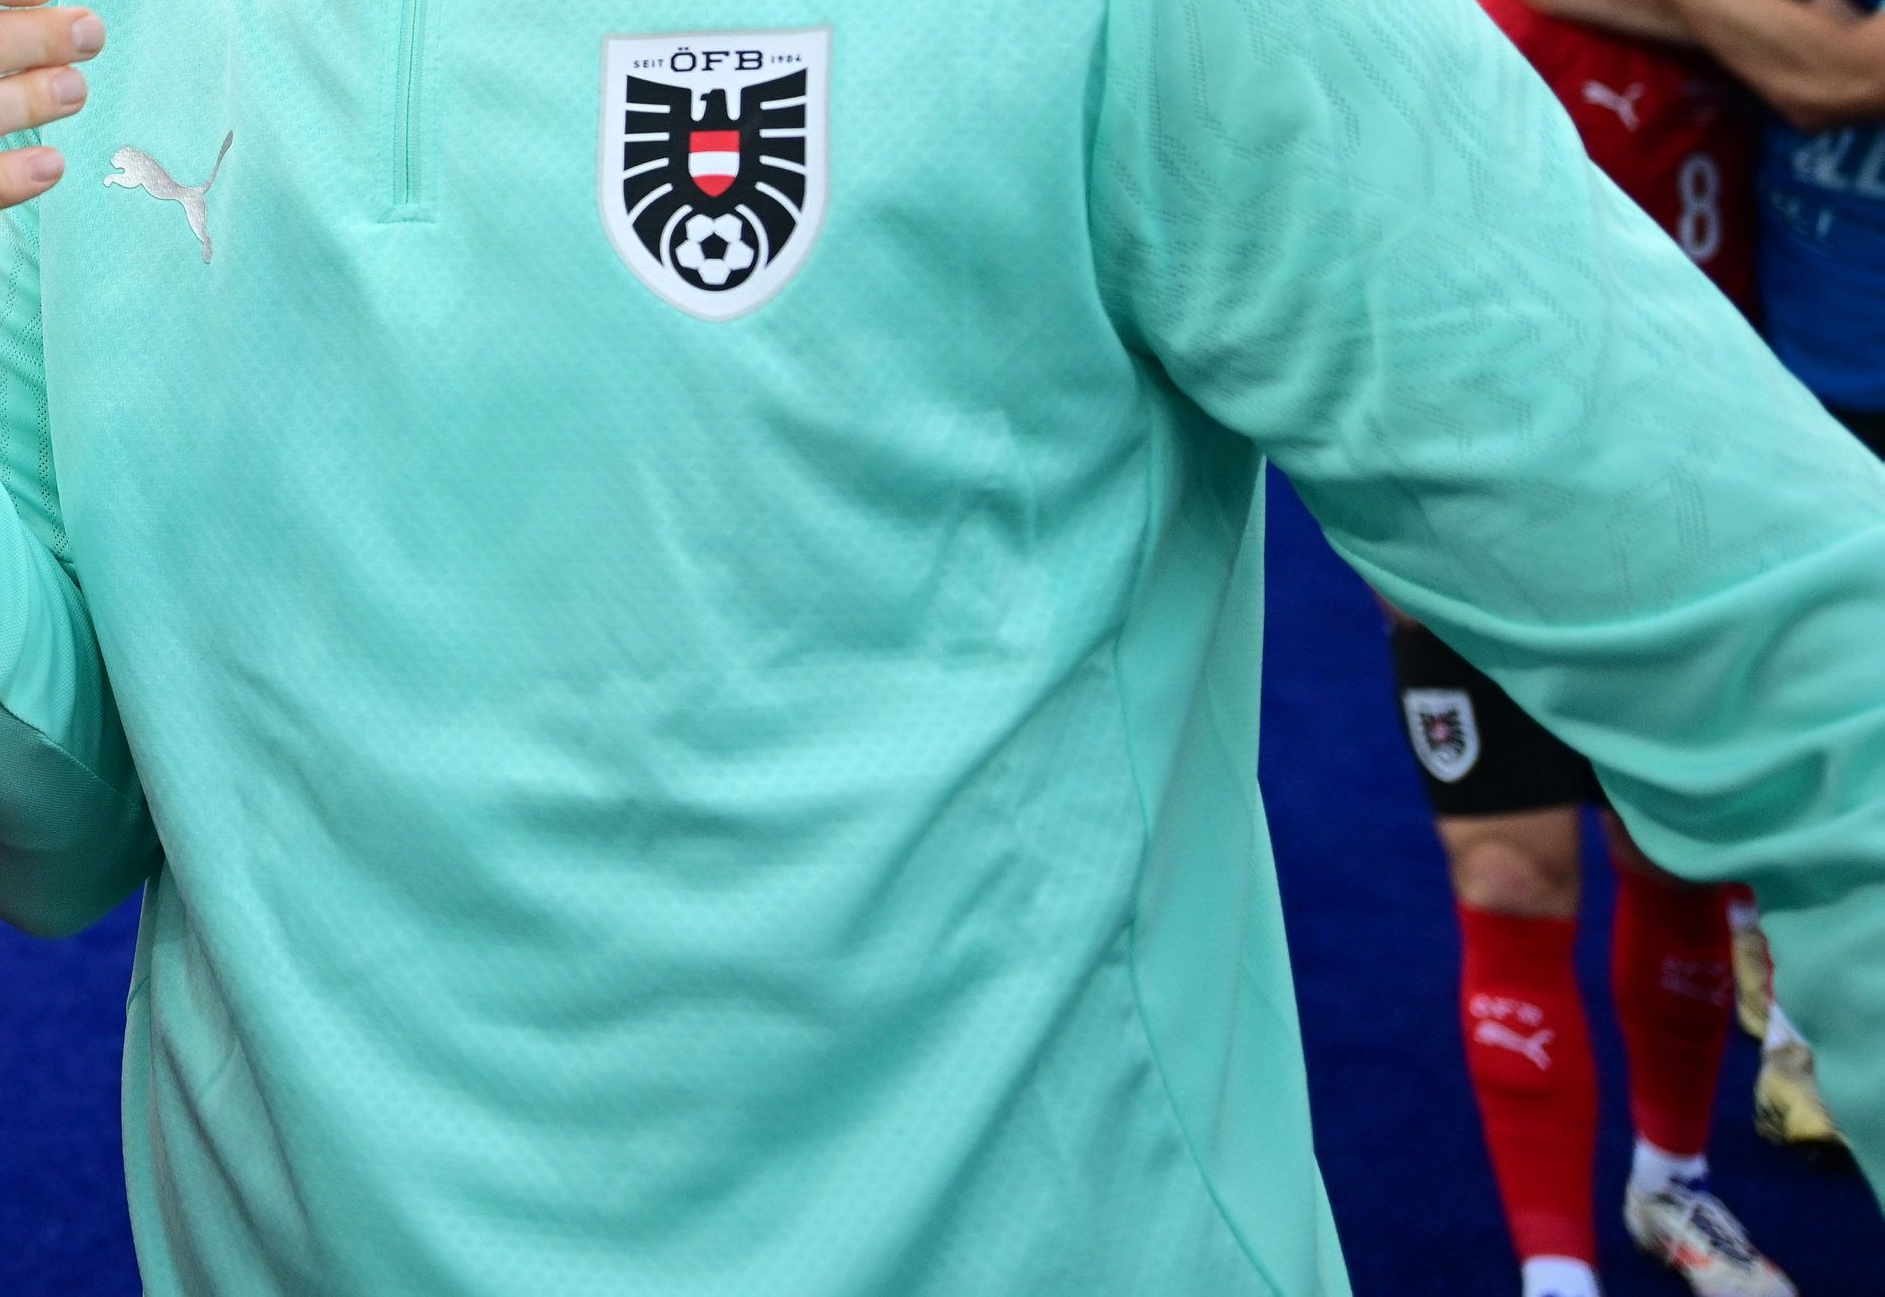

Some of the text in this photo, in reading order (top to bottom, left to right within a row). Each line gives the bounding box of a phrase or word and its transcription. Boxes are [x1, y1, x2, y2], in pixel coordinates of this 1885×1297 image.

[633, 46, 803, 72] SEIT ÖFB 1904
[1677, 151, 1722, 262] 8
